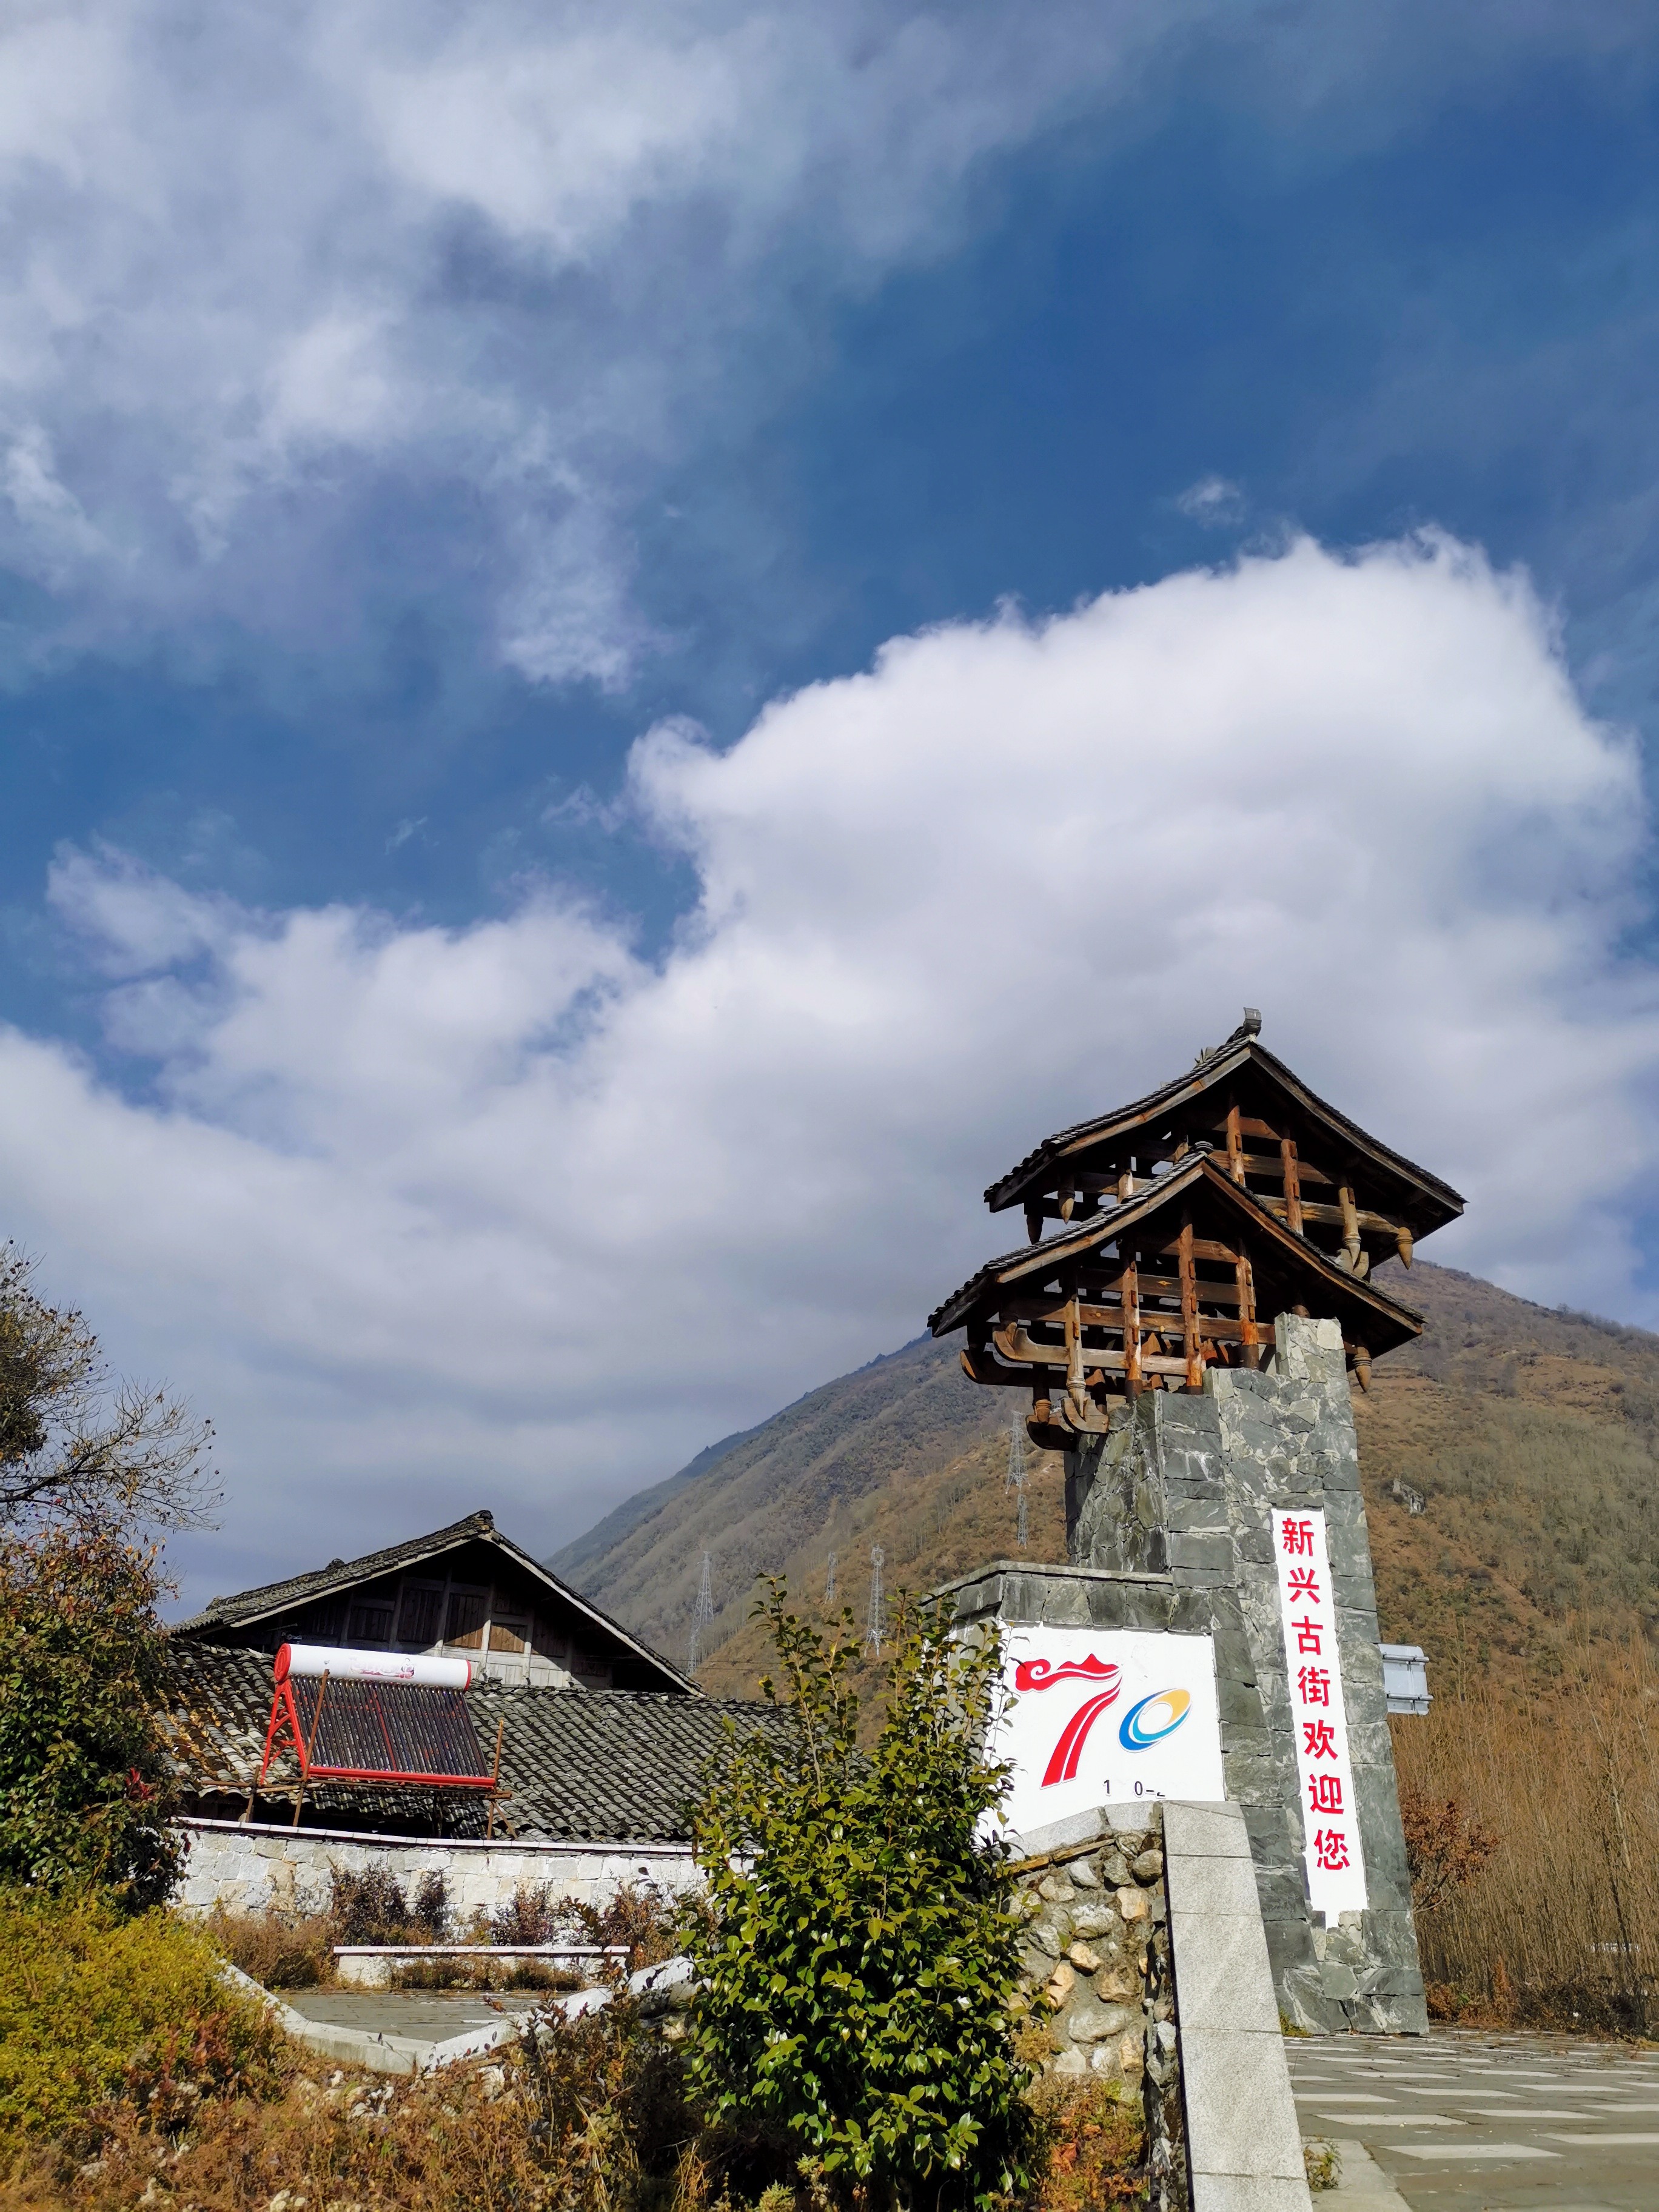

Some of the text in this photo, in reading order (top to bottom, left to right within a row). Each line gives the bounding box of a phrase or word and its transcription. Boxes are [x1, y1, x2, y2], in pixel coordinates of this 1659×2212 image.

[1281, 1517, 1350, 1871] 新兴古街欢迎您
